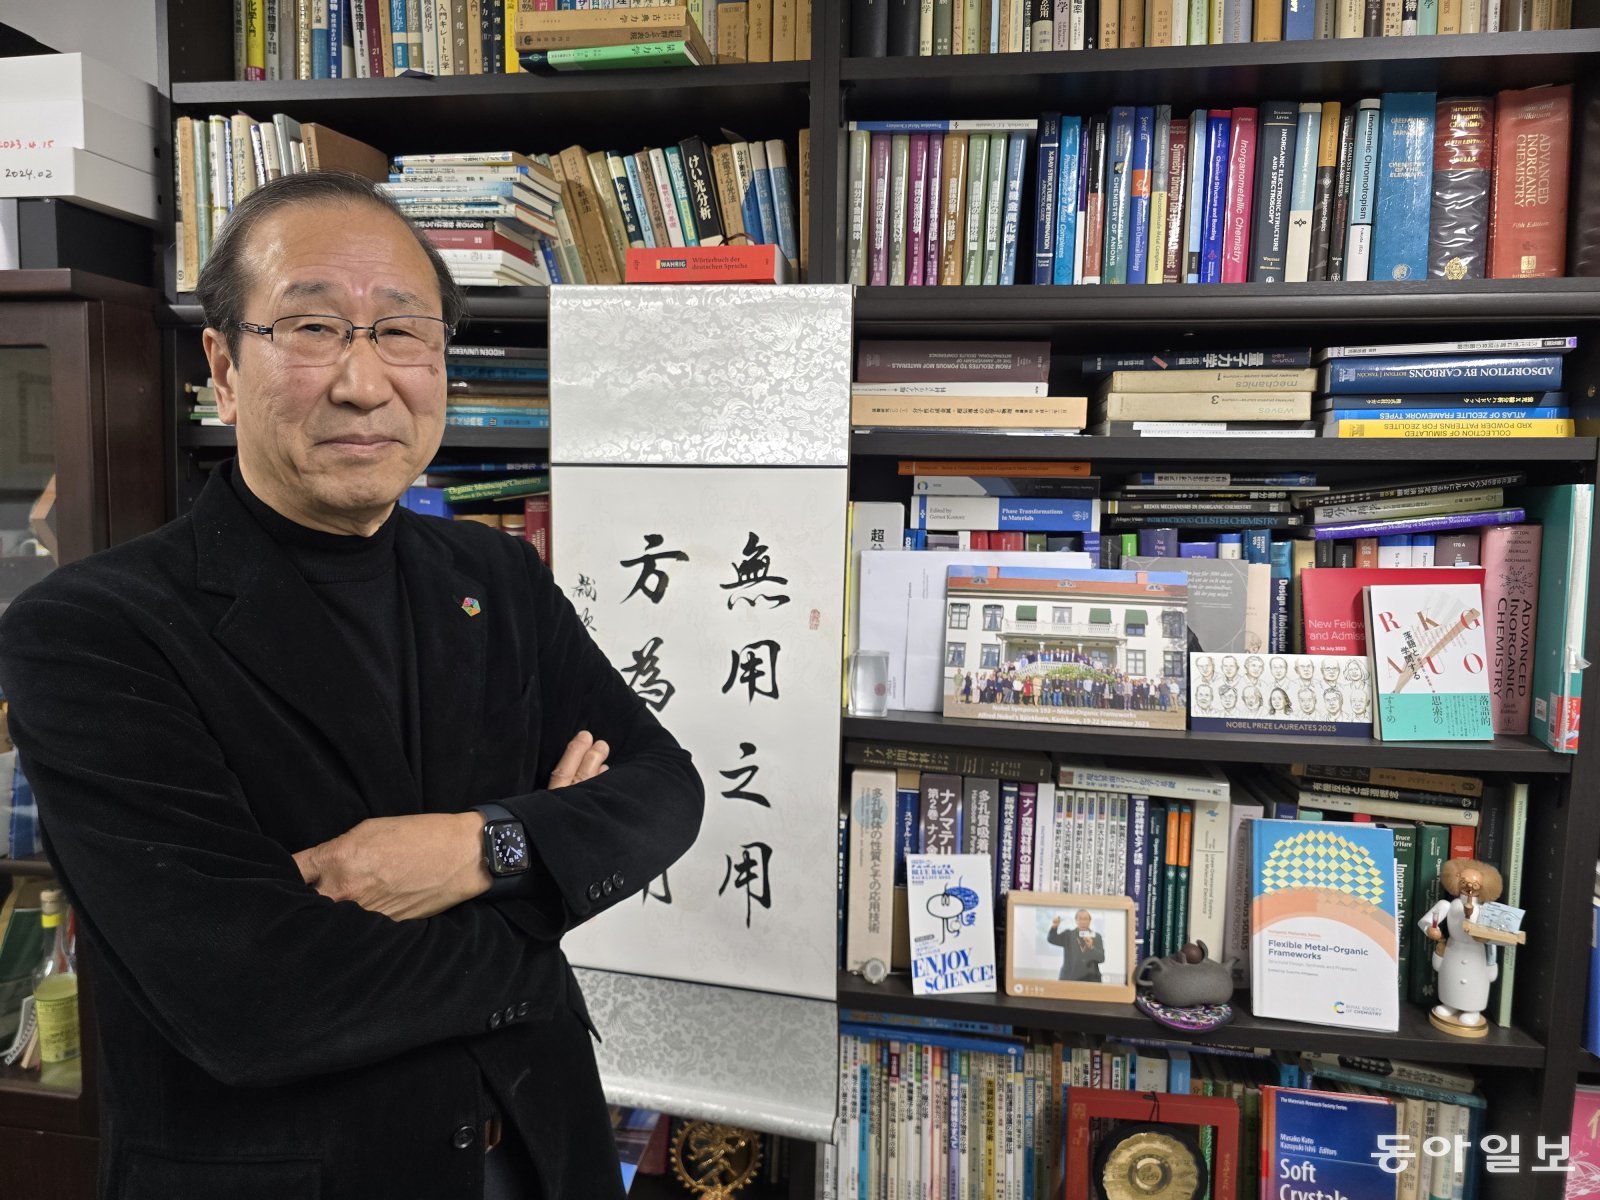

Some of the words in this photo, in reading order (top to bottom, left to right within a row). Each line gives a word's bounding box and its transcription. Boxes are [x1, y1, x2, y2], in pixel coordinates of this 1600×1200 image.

[439, 4, 450, 70] 入門キレート化学
[1279, 129, 1287, 168] INORGANIC
[1365, 114, 1375, 153] Inorganic
[1172, 144, 1183, 175] Symmetry
[1515, 134, 1526, 208] CHEMISTRY
[1526, 134, 1537, 206] INORGANIC
[1538, 133, 1551, 205] ADVANCED
[688, 155, 712, 221] けい光分析
[1170, 176, 1182, 201] through
[1235, 140, 1249, 213] Inorganometallic
[1276, 169, 1284, 212] ELECTRONIC
[1360, 155, 1372, 219] Chromotropism
[1111, 177, 1119, 222] CHEMISTRY
[1268, 172, 1276, 224] SPECTROSCOPY
[1320, 193, 1329, 232] Magneto-Optics
[1044, 203, 1052, 249] DETERMINATION
[1058, 224, 1066, 258] Complexes
[1112, 224, 1117, 234] OF
[1232, 217, 1246, 263] Chemistry
[1273, 212, 1281, 251] STRUCTURE
[660, 260, 686, 268] WAHRIG
[1133, 254, 1141, 271] Biology
[448, 348, 480, 356] UNIVERSE
[484, 349, 505, 357] HIDDEN
[1205, 352, 1264, 368] 量子力学
[1409, 368, 1462, 378] CARBONS
[1464, 369, 1478, 377] BY
[1478, 366, 1554, 377] ADSORPTION
[1211, 395, 1219, 404] 3
[1379, 412, 1403, 420] TYPES
[1195, 517, 1229, 525] CLUSTER
[1279, 579, 1289, 606] Design
[1278, 615, 1289, 652] Molecular
[1309, 620, 1331, 629] New
[1309, 632, 1329, 640] and
[1403, 631, 1420, 656] 落語と
[1493, 598, 1507, 699] CHEMISTRY
[1505, 598, 1520, 699] INORGANIC
[1518, 600, 1533, 697] ADVANCED
[1400, 647, 1421, 680] 学問する
[1385, 696, 1396, 723] すすめ
[1431, 696, 1444, 725] 思索の
[1479, 695, 1491, 726] 落語的
[719, 531, 791, 928] 無用之用
[1252, 722, 1273, 730] PRIZE
[1274, 723, 1316, 731] LAUREATES
[927, 788, 939, 821] 第2巻
[868, 787, 883, 934] 多孔質体の性質とその応用技術
[1241, 919, 1249, 950] SOLIDS
[1268, 939, 1302, 950] Flexible
[913, 948, 973, 978] ENJOY
[1268, 949, 1322, 961] Frameworks
[925, 964, 994, 993] SCIENCE!
[1353, 1009, 1382, 1017] CHEMISTRY
[1280, 1134, 1301, 1143] Masako
[1301, 1136, 1314, 1144] Kato
[1280, 1142, 1304, 1152] Kazuyuki
[1305, 1145, 1316, 1153] Ishii
[1319, 1147, 1337, 1156] Editors
[1280, 1158, 1316, 1184] Soft
